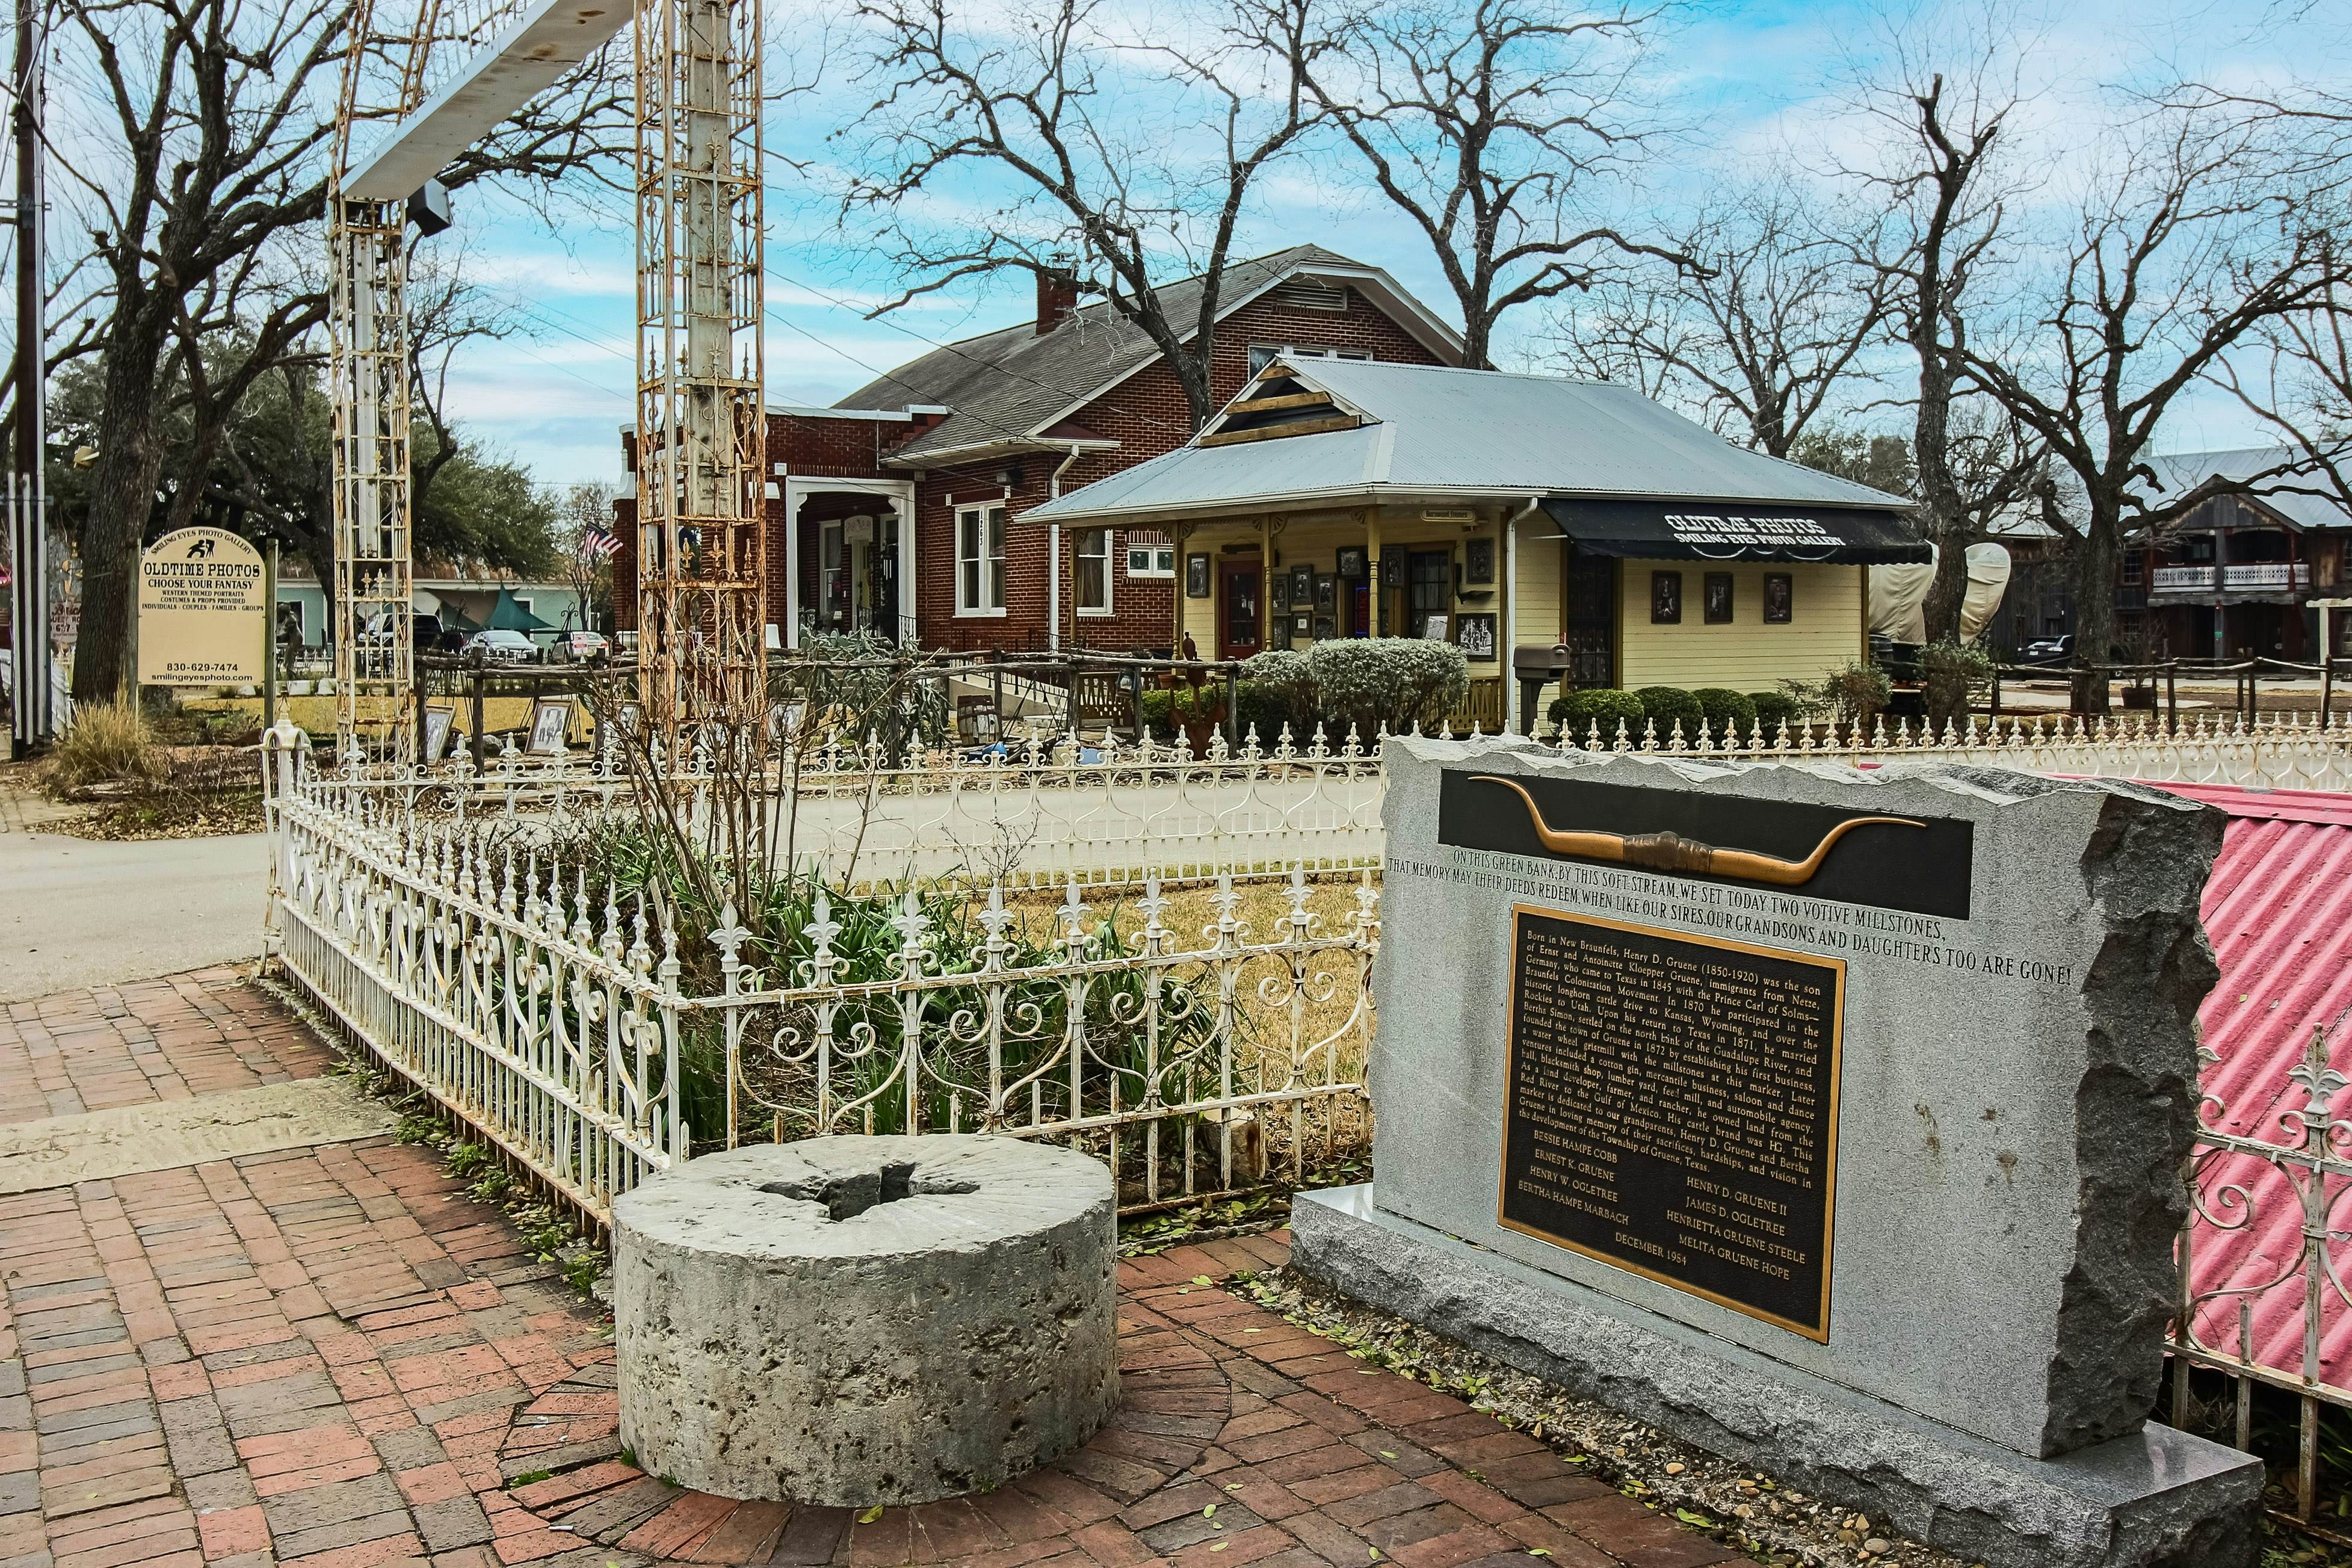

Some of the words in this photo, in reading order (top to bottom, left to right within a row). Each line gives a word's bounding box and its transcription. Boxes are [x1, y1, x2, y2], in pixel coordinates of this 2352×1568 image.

[151, 536, 176, 555] SMILING
[177, 529, 196, 539] EYES
[198, 529, 223, 538] PHOTO
[224, 535, 253, 555] GALLERY
[1664, 514, 1756, 533] OLDTIME
[1749, 517, 1827, 534] PHOTOS
[1673, 532, 1728, 544] SMILING
[1727, 534, 1758, 545] EYES
[1758, 534, 1797, 545] PHOTO
[1795, 536, 1846, 546] GALLERY
[144, 563, 204, 576] OLDTIME
[208, 563, 260, 578] PHOTOS
[148, 579, 185, 588] CHOOSE
[188, 579, 212, 589] YOUR
[215, 580, 254, 590] FANTASY
[151, 673, 253, 682] smilingeyesphoto.com
[167, 663, 238, 671] 830-629-7474
[1454, 848, 1466, 865] ON
[1468, 850, 1490, 868] THIS
[1492, 854, 1523, 874] GREEN
[1575, 866, 1598, 885] THIS
[1602, 871, 1628, 890] SOFT
[1702, 886, 1722, 905] SET
[1727, 889, 1767, 912] TODAY
[1772, 897, 1798, 917] TWO
[1803, 901, 1850, 925] VOTIVE
[1854, 909, 1945, 941] MILLSTONES,
[1388, 857, 1410, 875] THAT
[1412, 862, 1450, 882] MEMORY
[1452, 868, 1472, 886] MAY
[1474, 872, 1502, 890] THEIR
[1505, 877, 1535, 897] DEEDS
[1616, 895, 1639, 914] LIKE
[1643, 899, 1665, 918] OUR
[1707, 909, 1732, 930] OUR
[1735, 914, 1815, 943] GRANDSONS
[1817, 927, 1847, 949] AND
[1853, 933, 1940, 965] DAUGHTERS
[1946, 948, 1976, 970] TOO
[1982, 954, 2013, 977] ARE
[2020, 960, 2071, 986] GONE!
[1526, 943, 1534, 952] of
[1540, 945, 1559, 957] Ernst
[1564, 951, 1577, 960] and
[1582, 954, 1623, 969] Antoinette
[1629, 962, 1664, 978] Kloepper
[1670, 971, 1702, 987] Gruene,
[1709, 979, 1756, 996] immigrants
[1764, 989, 1785, 1002] from
[1792, 995, 1820, 1010] Netze,
[1527, 931, 1545, 942] Born
[1549, 934, 1556, 944] in
[1560, 937, 1576, 947] New
[1580, 940, 1619, 957] Braunfels,
[1623, 949, 1648, 963] Henry
[1652, 954, 1662, 965] D.
[1666, 957, 1697, 971] Gruene
[1702, 964, 1758, 984] (1850-1920)
[1763, 978, 1780, 987] was
[1785, 980, 1799, 991] the
[1804, 986, 1821, 996] son
[1525, 966, 1559, 981] Braunfels
[1564, 975, 1611, 992] Colonization
[1617, 986, 1661, 1002] Movement.
[1668, 996, 1676, 1006] In
[1684, 999, 1704, 1012] 1870
[1711, 1004, 1721, 1016] he
[1727, 1011, 1780, 1028] participated
[1787, 1022, 1796, 1032] in
[1804, 1025, 1819, 1037] the
[1526, 954, 1560, 970] Germany,
[1564, 963, 1579, 973] who
[1582, 968, 1600, 977] came
[1616, 972, 1637, 985] Texas
[1640, 978, 1648, 987] in
[1653, 980, 1671, 992] 1845
[1676, 987, 1694, 997] with
[1698, 989, 1711, 1001] the
[1715, 992, 1741, 1007] Prince
[1745, 999, 1764, 1011] Carl
[1768, 1004, 1778, 1014] of
[1525, 978, 1552, 992] historic
[1558, 985, 1590, 1000] longhorn
[1596, 996, 1617, 1006] cattle
[1623, 999, 1643, 1011] drive
[1664, 1008, 1694, 1025] Kansas,
[1702, 1016, 1745, 1036] Wyoming,
[1753, 1029, 1768, 1040] and
[1776, 1035, 1796, 1046] over
[1803, 1039, 1818, 1050] the
[1522, 1039, 1552, 1052] ventures
[1555, 1046, 1587, 1061] included
[1599, 1059, 1623, 1070] cotton
[1627, 1065, 1641, 1076] gin,
[1646, 1071, 1687, 1087] mercantile
[1692, 1079, 1729, 1099] business,
[1734, 1092, 1762, 1107] saloon
[1767, 1101, 1783, 1112] and
[1788, 1104, 1815, 1120] dance
[1534, 1130, 1560, 1146] BESSIE
[1562, 1138, 1592, 1155] HAMPE
[1593, 1149, 1617, 1163] COBB
[1535, 1149, 1567, 1166] ERNEST
[1568, 1159, 1576, 1170] K.
[1578, 1162, 1615, 1182] GRUENE
[1518, 1180, 1551, 1199] BERTHA
[1552, 1191, 1582, 1209] HAMPE
[1584, 1202, 1629, 1225] MARBACH
[1530, 1165, 1558, 1182] HENRY
[1560, 1175, 1570, 1187] W.
[1572, 1180, 1618, 1202] OGLETREE
[1687, 1176, 1720, 1194] HENRY
[1722, 1187, 1732, 1199] D.
[1735, 1191, 1777, 1212] GRUENE
[1779, 1204, 1787, 1216] II
[1686, 1196, 1717, 1214] JAMES
[1719, 1206, 1729, 1218] D.
[1732, 1211, 1785, 1236] OGLETREE
[1616, 1232, 1664, 1257] DECEMBER
[1667, 1250, 1687, 1265] 1984
[1667, 1210, 1721, 1236] HENRIETTA
[1723, 1229, 1765, 1251] GRUENE
[1768, 1243, 1806, 1264] STEELE
[1679, 1234, 1715, 1255] MELITA
[1717, 1248, 1759, 1270] GRUENE
[1762, 1262, 1789, 1280] HOPE
